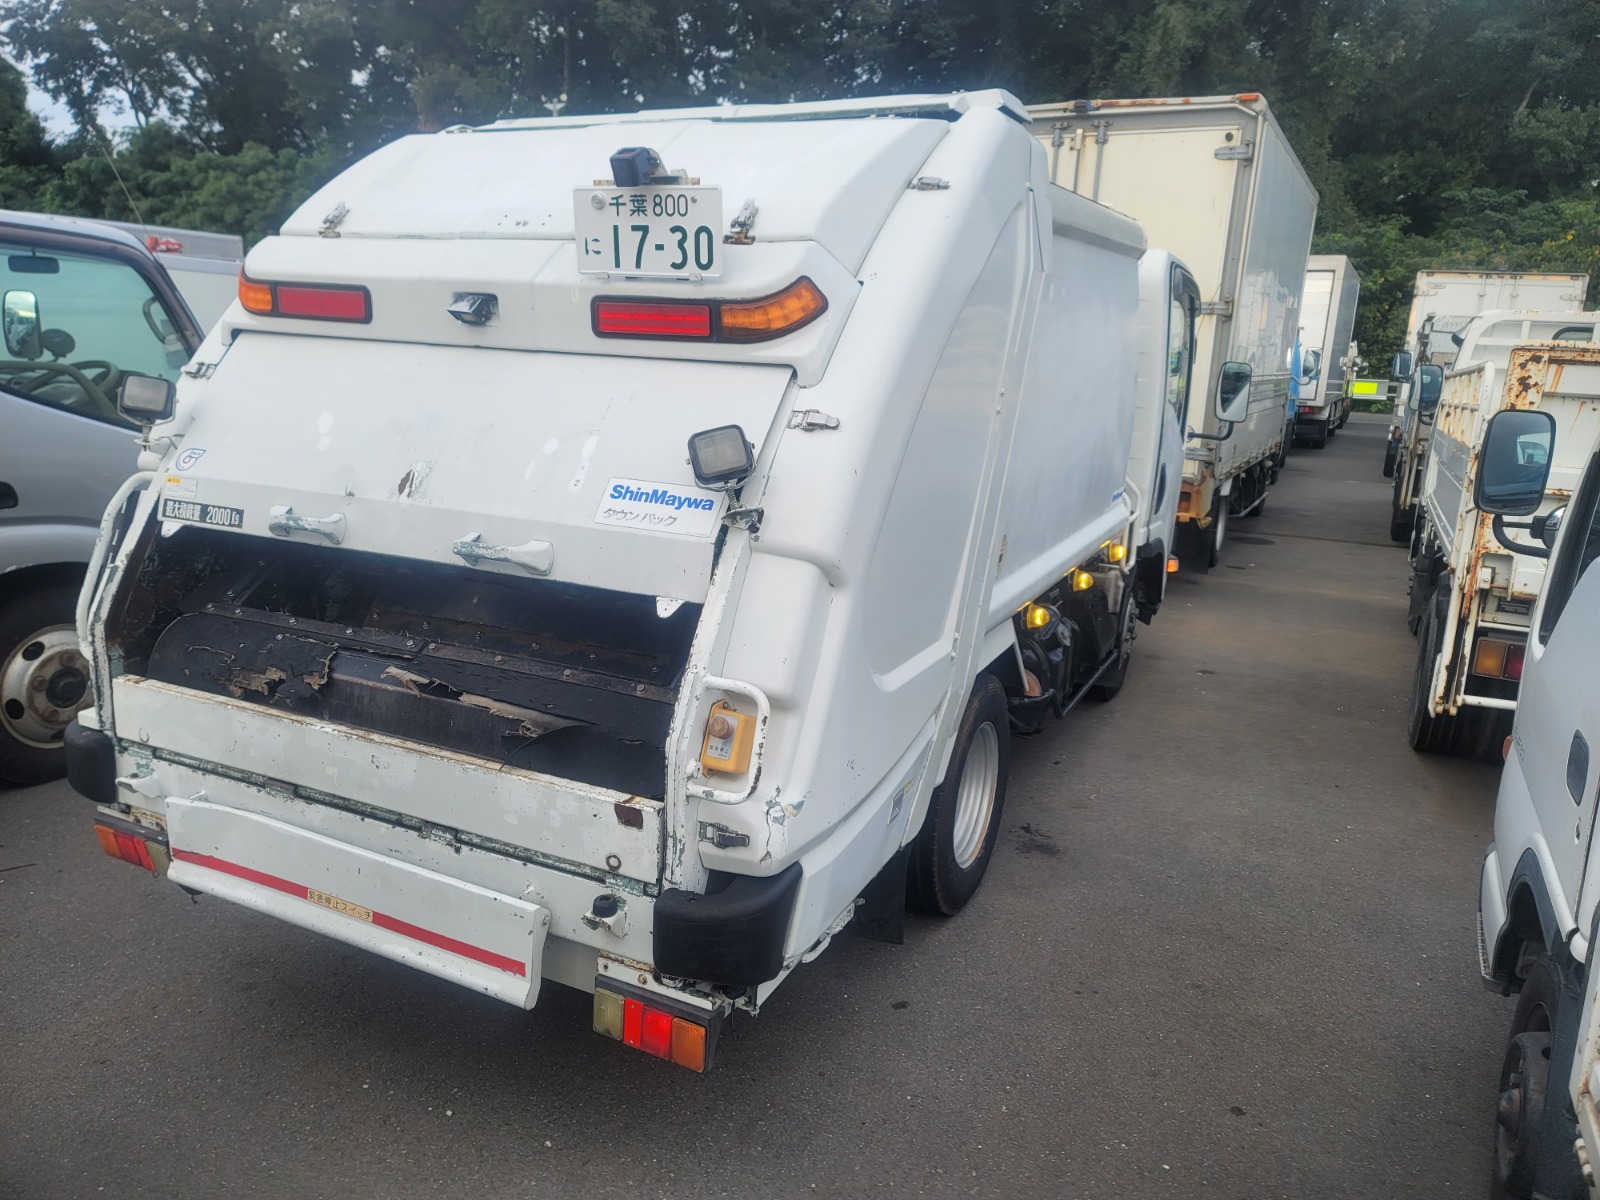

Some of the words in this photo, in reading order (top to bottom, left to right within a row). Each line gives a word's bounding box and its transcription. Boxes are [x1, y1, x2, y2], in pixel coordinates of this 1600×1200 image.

[609, 194, 648, 217] 千葉
[653, 194, 688, 217] 800
[585, 236, 602, 256] に
[613, 224, 714, 271] 17-30
[610, 484, 715, 511] ShinMaywa
[308, 890, 372, 919] 緊急停止スイッチ
